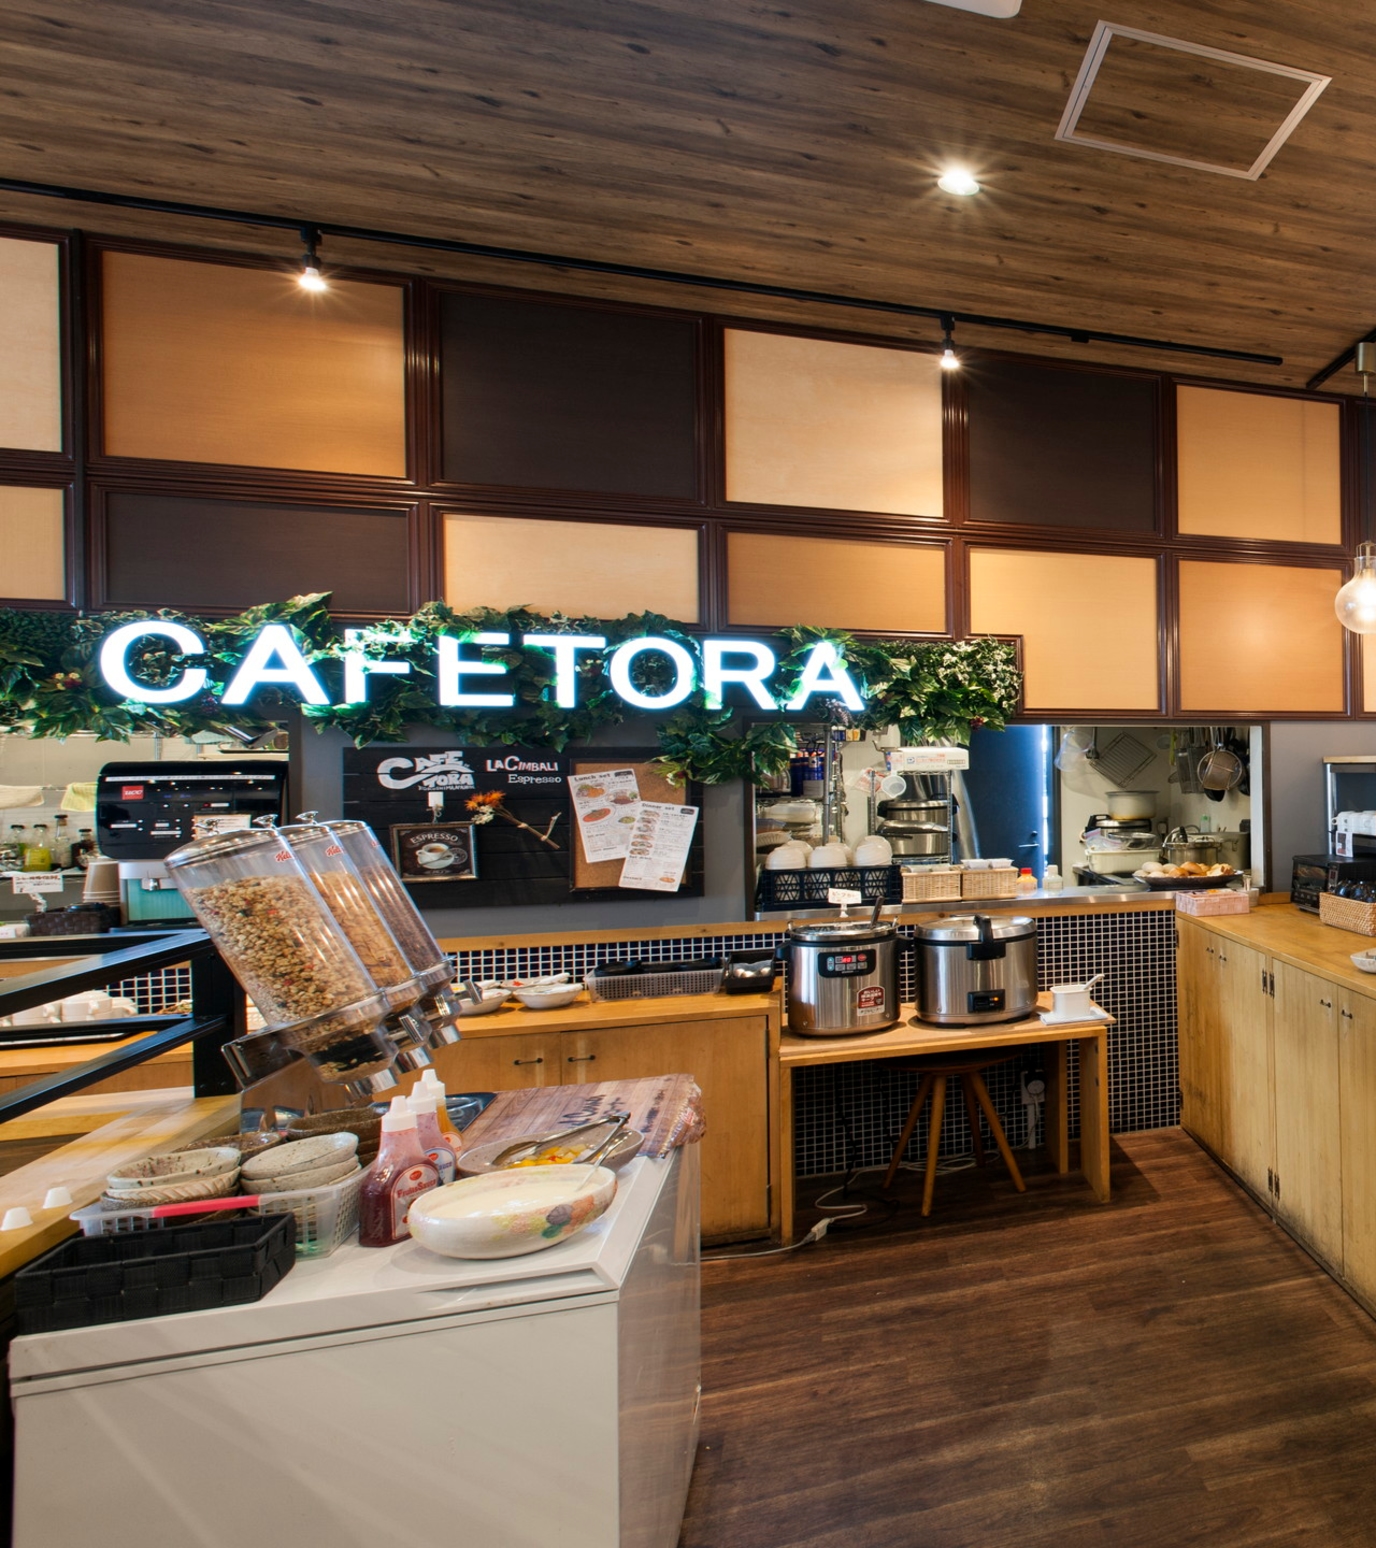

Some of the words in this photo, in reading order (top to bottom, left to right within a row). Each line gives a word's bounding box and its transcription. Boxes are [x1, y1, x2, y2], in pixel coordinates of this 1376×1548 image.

[99, 620, 866, 712] CAFETORA
[422, 772, 475, 788] TORA
[508, 774, 562, 784] Espresso
[641, 802, 662, 810] Dinner
[410, 832, 459, 845] ESPRESSO
